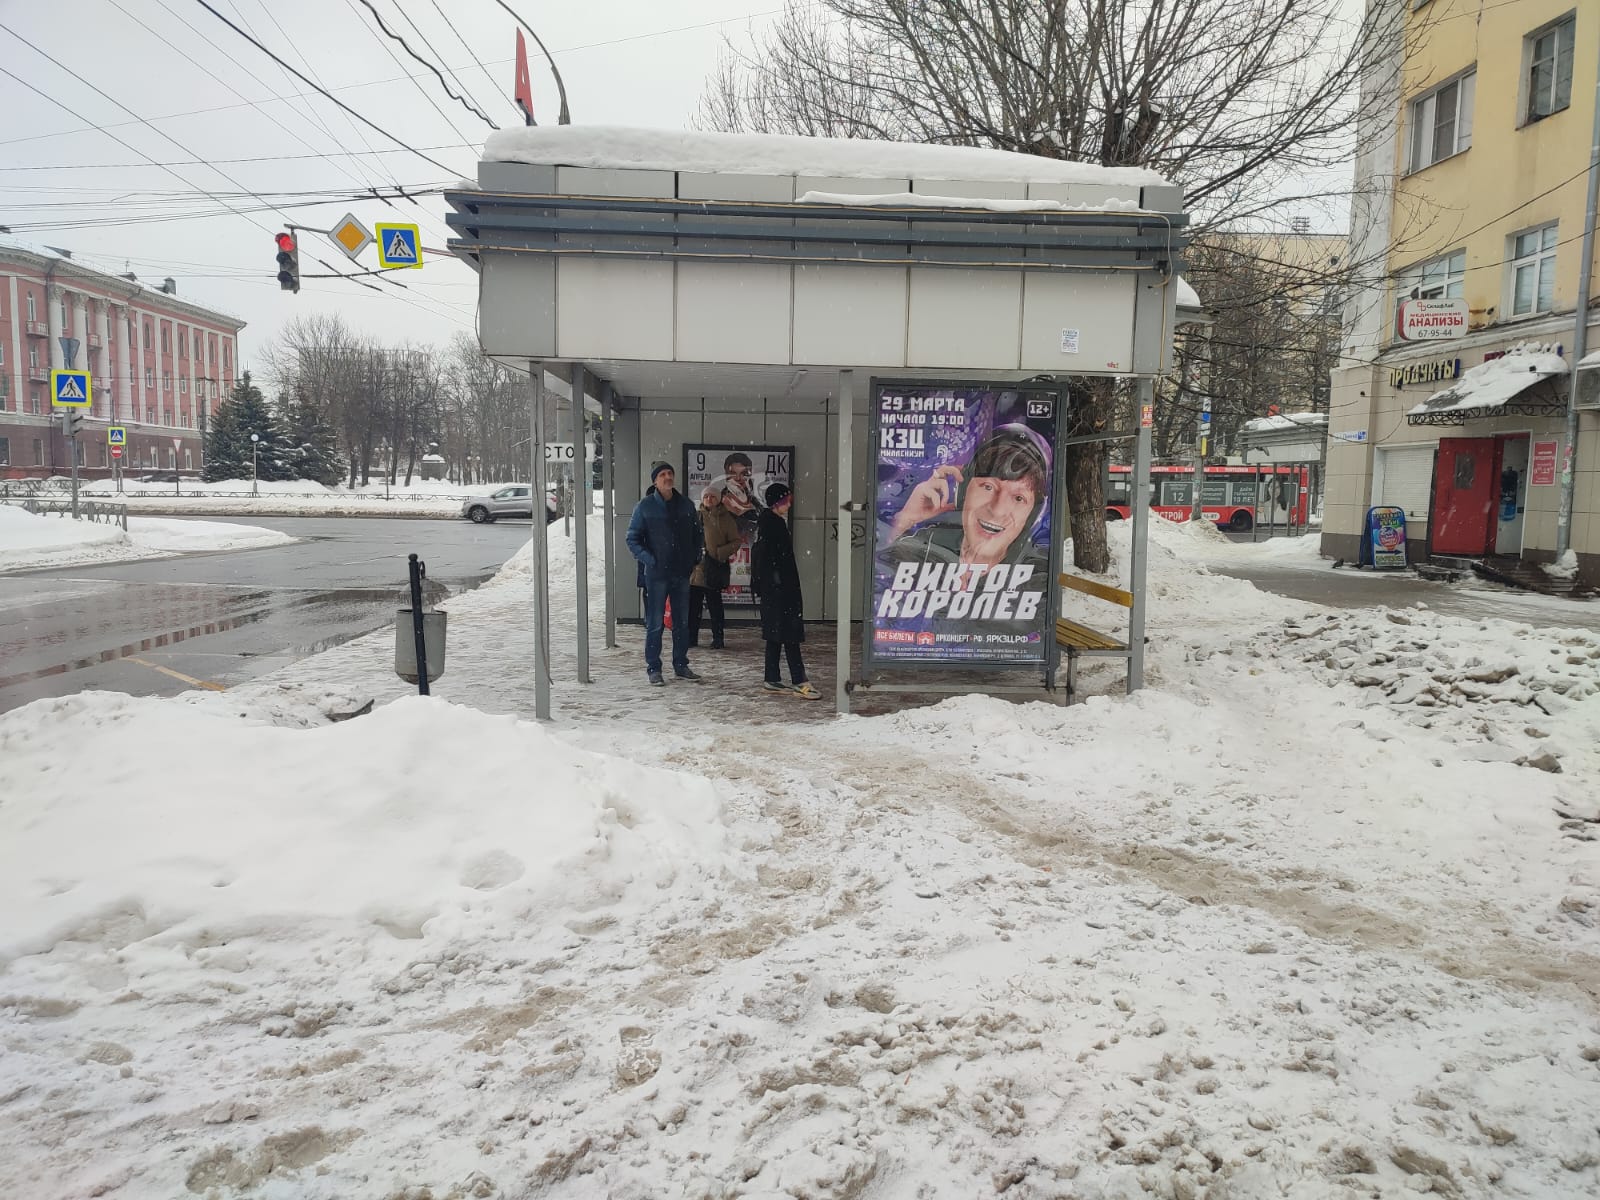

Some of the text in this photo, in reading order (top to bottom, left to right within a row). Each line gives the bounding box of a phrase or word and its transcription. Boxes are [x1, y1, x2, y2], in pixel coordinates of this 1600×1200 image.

[1408, 316, 1464, 328] АНАЛИЗЫ
[1418, 328, 1453, 338] 67-95-44
[1388, 359, 1459, 388] ПРОДУКТЫ
[881, 396, 965, 412] 29 МАРТА
[1029, 404, 1049, 414] 12+
[881, 413, 964, 425] НАЧАЛО 19:00
[880, 427, 925, 449] КЗЦ
[545, 446, 587, 458] СТО
[696, 452, 706, 471] 9
[764, 454, 788, 476] ДК
[689, 473, 712, 481] АПРЕЛЯ
[1173, 491, 1184, 502] 12
[1156, 509, 1184, 521] СТРОЙ
[891, 561, 1035, 593] ВИКТОР
[877, 588, 1043, 620] КОРОЛЁВ
[876, 630, 914, 641] ВСЕ БИЛЕТЫ
